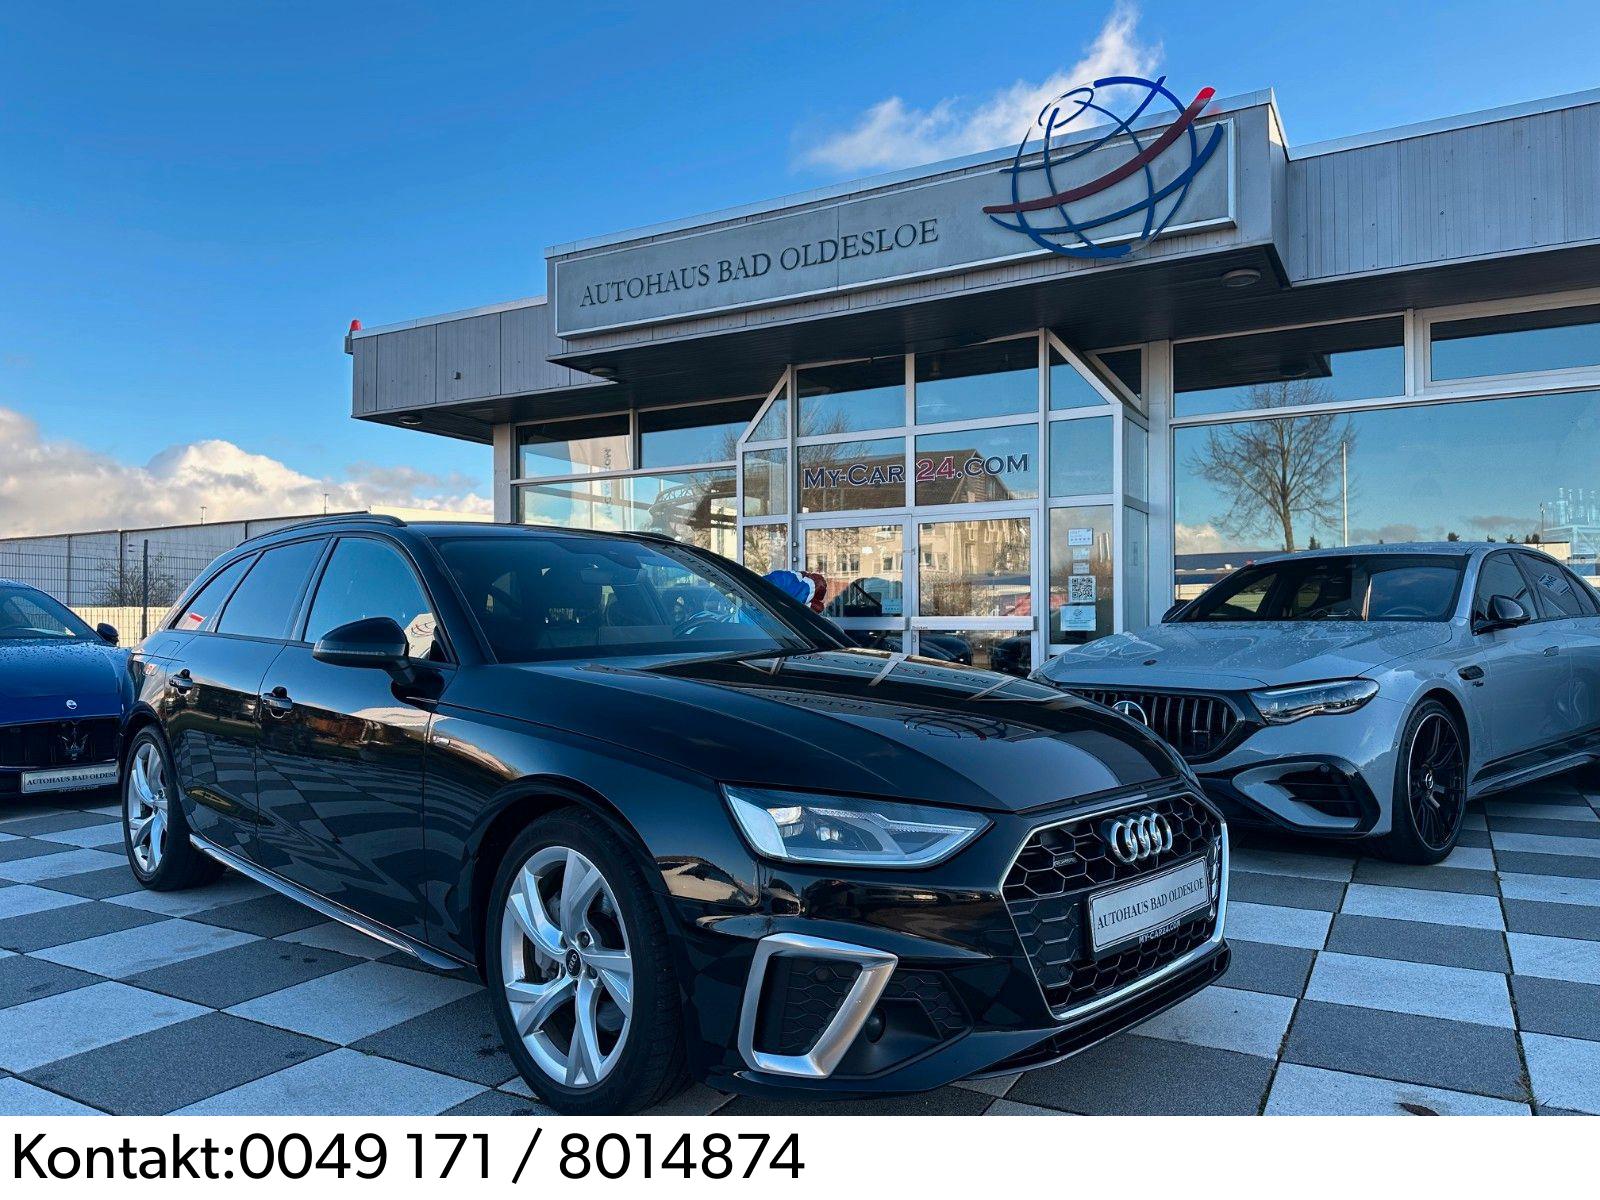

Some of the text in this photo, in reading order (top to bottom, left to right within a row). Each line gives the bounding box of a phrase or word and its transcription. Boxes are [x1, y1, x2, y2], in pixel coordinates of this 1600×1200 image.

[579, 217, 939, 308] AUTOHAUS BAD OLDESLOE
[26, 776, 70, 786] AUTOHAUS
[90, 771, 116, 780] OLDESL
[1097, 877, 1204, 930] AUTOHAUS BAD OLDESLOE
